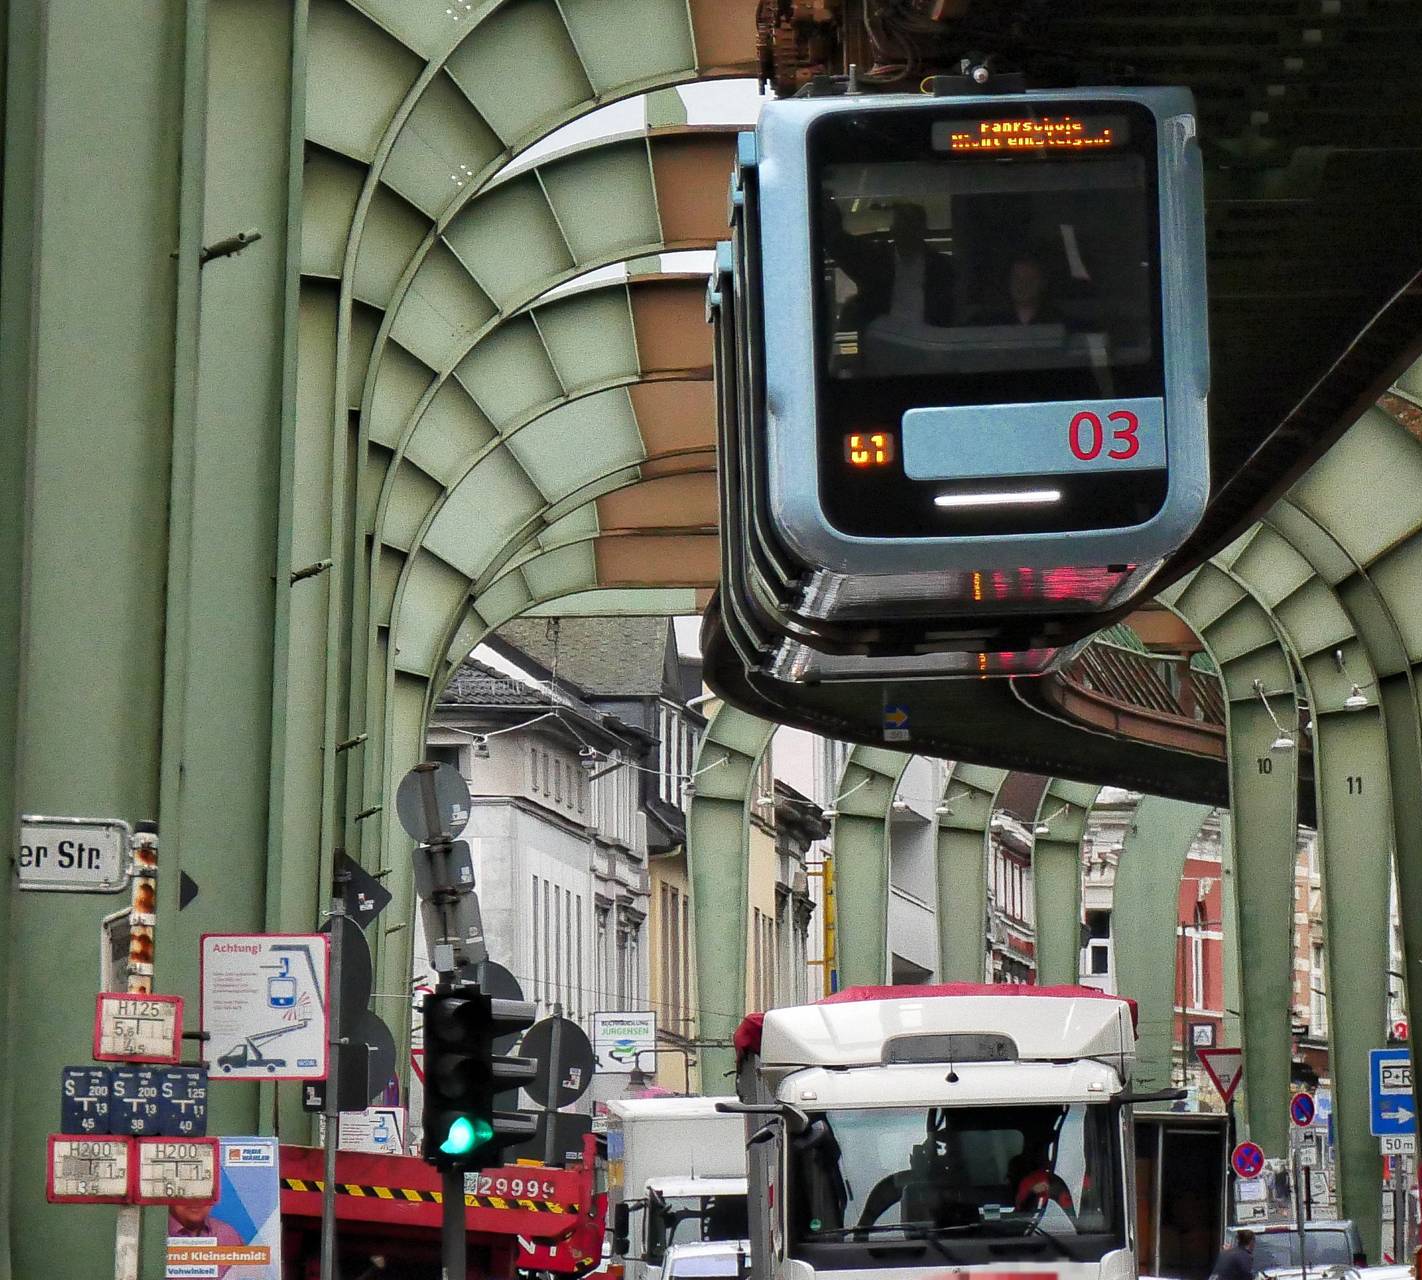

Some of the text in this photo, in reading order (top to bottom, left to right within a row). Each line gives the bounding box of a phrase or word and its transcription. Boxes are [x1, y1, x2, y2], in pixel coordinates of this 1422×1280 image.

[1068, 410, 1140, 461] 03
[1257, 757, 1272, 774] 10
[1346, 776, 1362, 794] 11
[58, 840, 100, 869] Str.
[213, 944, 262, 955] Achtung!
[118, 1000, 160, 1017] H125
[65, 1080, 75, 1096] S
[89, 1086, 108, 1096] 200
[113, 1081, 125, 1097] S
[138, 1087, 157, 1097] 200
[162, 1082, 173, 1098] S
[187, 1088, 206, 1098] 125
[95, 1103, 107, 1113] 13
[144, 1104, 157, 1114] 13
[194, 1105, 204, 1115] 11
[81, 1118, 95, 1129] 45
[130, 1119, 144, 1129] 38
[179, 1120, 193, 1131] 40
[70, 1143, 112, 1157] H200
[1385, 1139, 1401, 1150] 50
[156, 1144, 198, 1159] H200
[479, 1176, 555, 1198] 29999
[192, 1251, 266, 1260] Kleinschmidt
